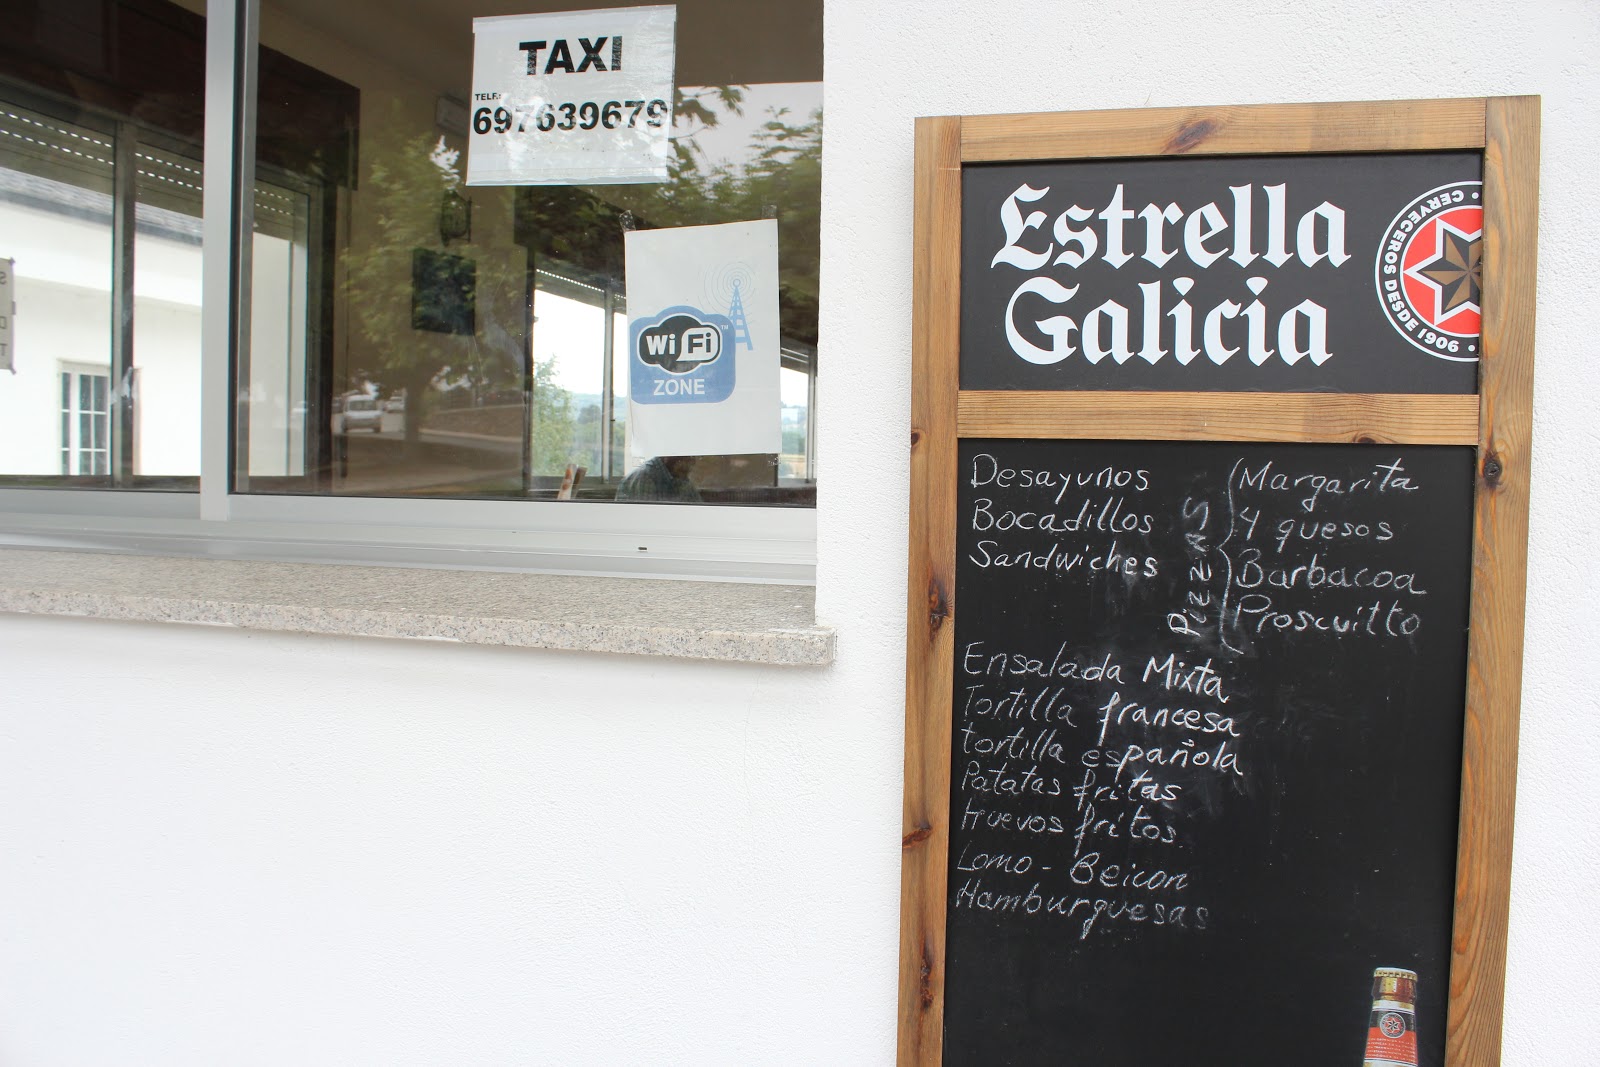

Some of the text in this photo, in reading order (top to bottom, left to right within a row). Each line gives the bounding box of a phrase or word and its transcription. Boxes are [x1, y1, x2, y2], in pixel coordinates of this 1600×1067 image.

[519, 36, 623, 76] TAXI
[473, 99, 668, 134] 697639679
[991, 182, 1352, 271] Estrella
[1383, 190, 1464, 353] CERVECEROS DESDE 1906
[1005, 277, 1333, 366] Galicia
[653, 378, 705, 397] ZONE
[971, 454, 1150, 505] Desayunos
[1238, 458, 1419, 512] Margarita
[972, 498, 1153, 534] Bocadillos
[1277, 517, 1394, 553] quesos
[969, 540, 1159, 578] Sandwiches
[1236, 548, 1427, 596] Barbacoa
[964, 641, 1230, 703] Ensalada Mixta
[964, 684, 1241, 746] Tortilla francesa
[961, 723, 1244, 781] tortilla española
[961, 760, 1182, 811] Patatas fritas
[960, 800, 1176, 857] Huevos fritos
[957, 843, 1033, 874] Lomo
[1069, 852, 1189, 890] Beicon
[955, 878, 1209, 939] Hamburguesas
